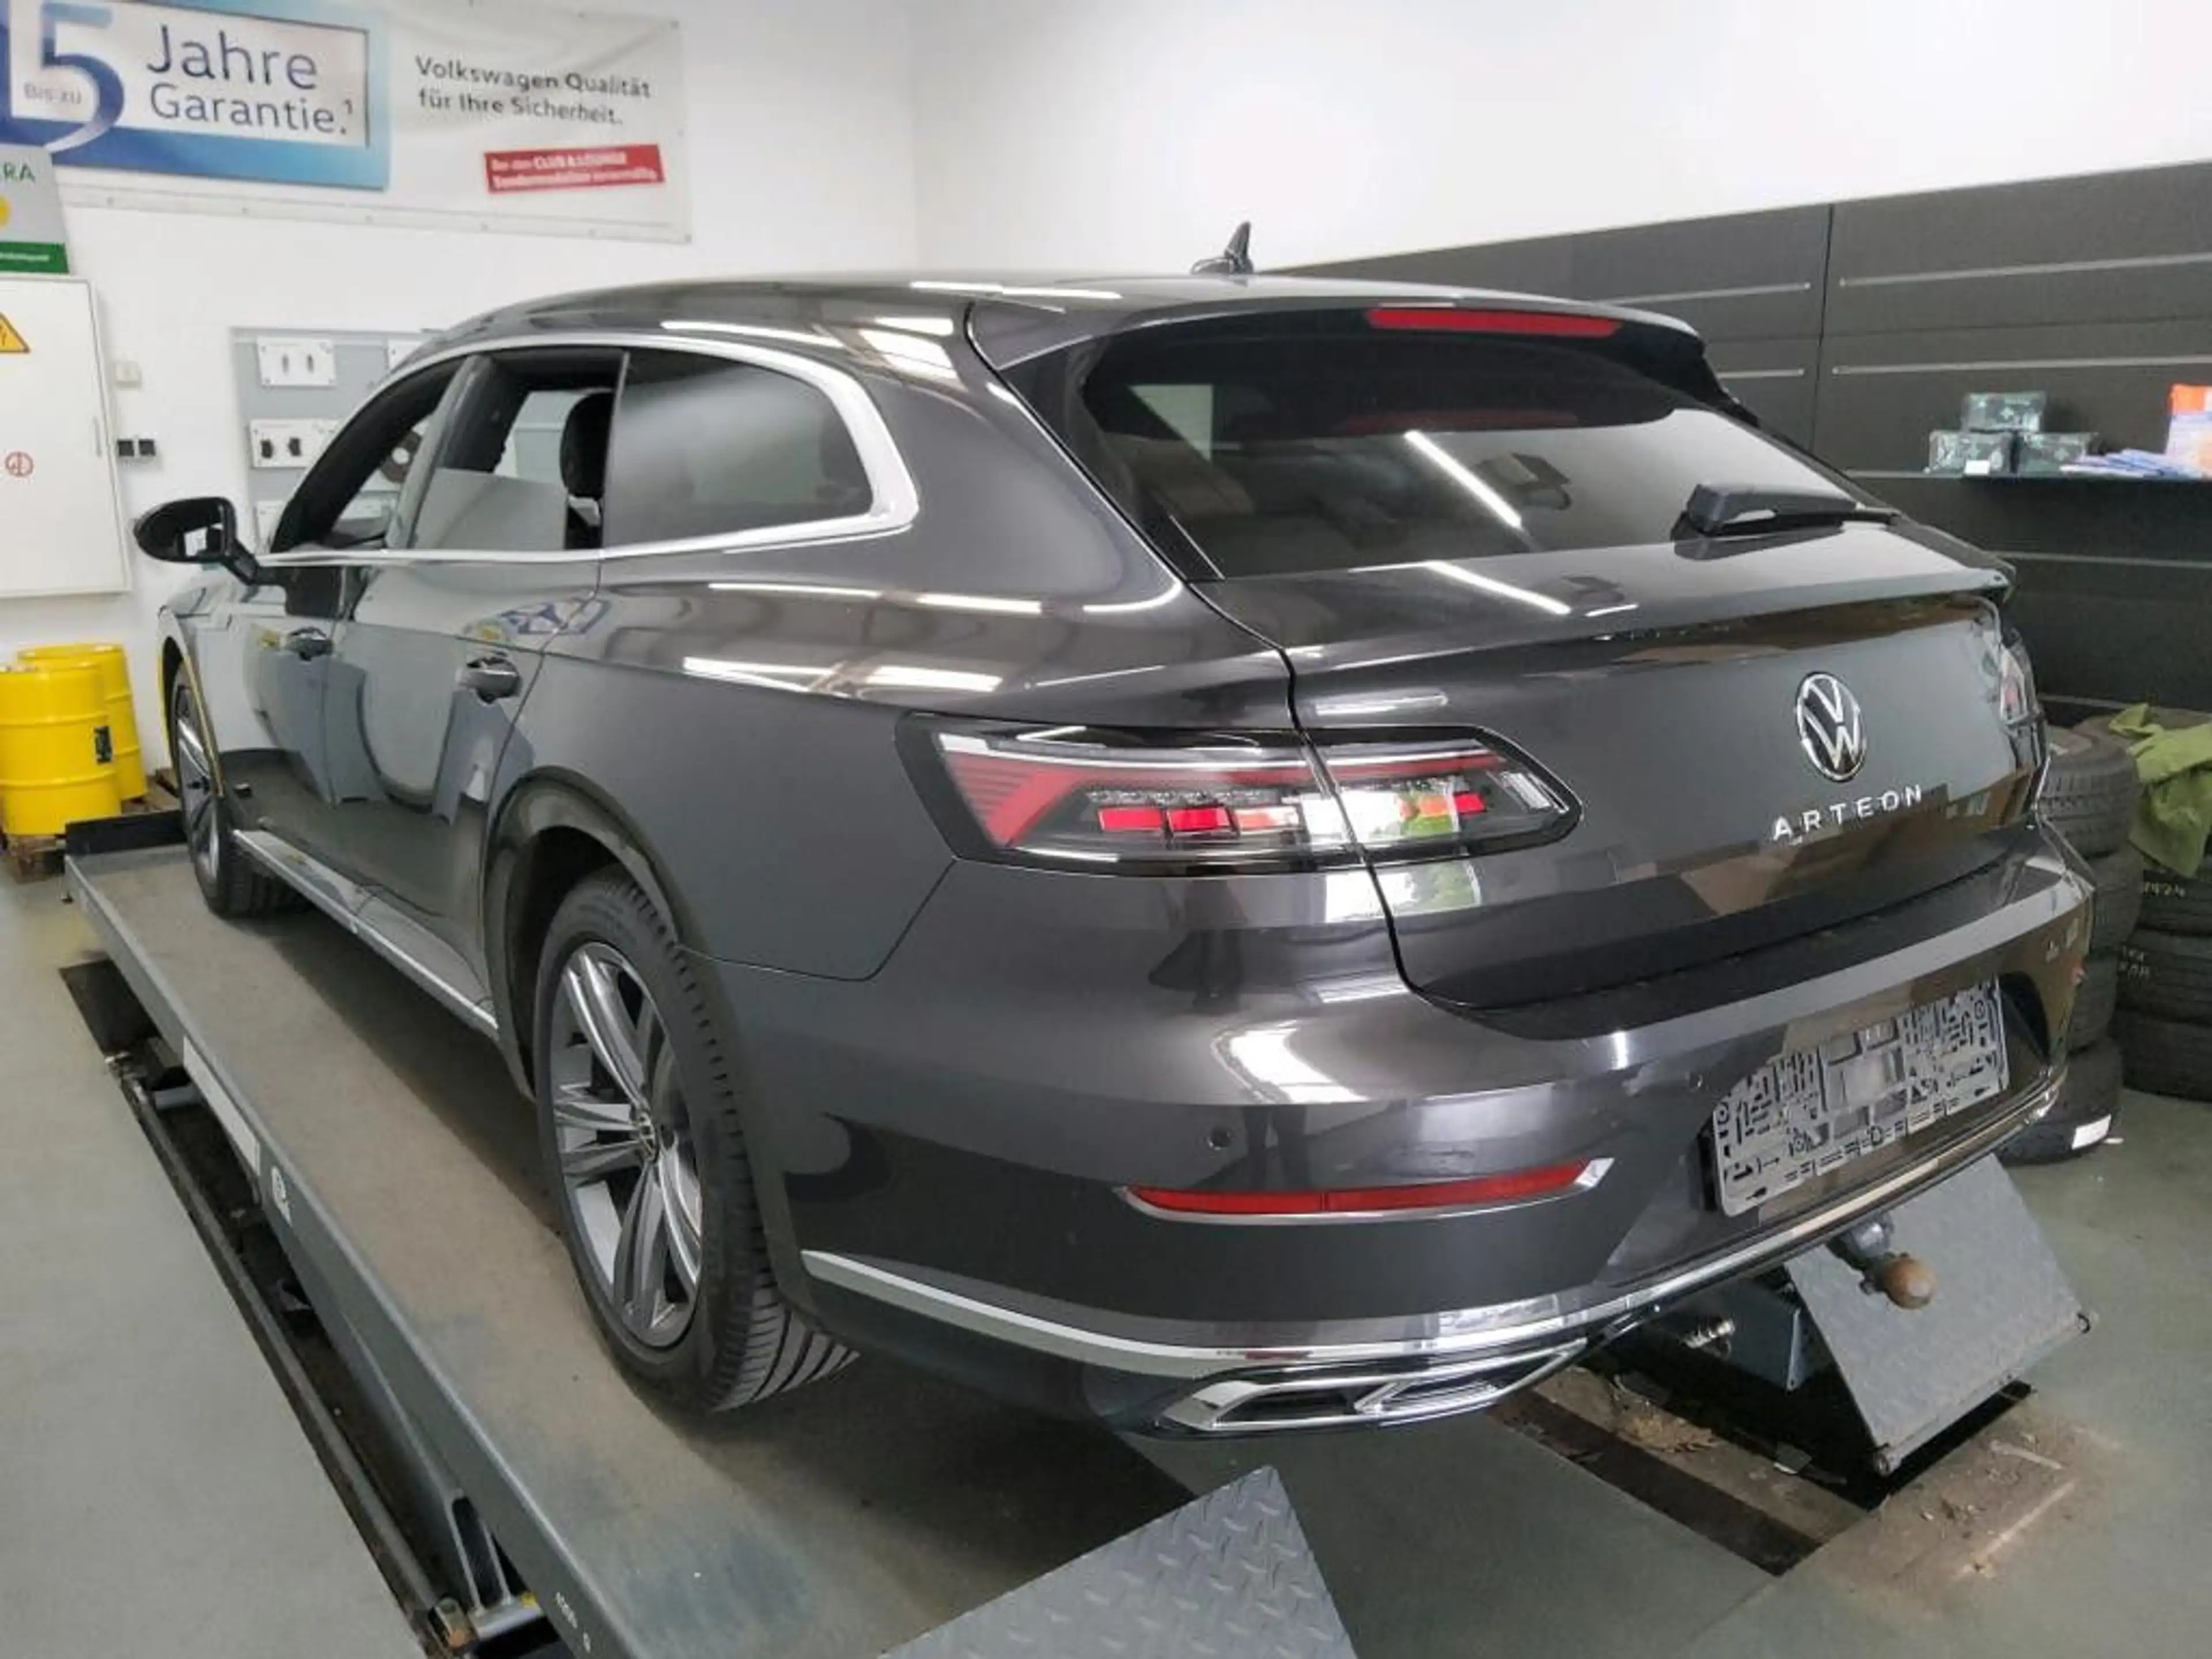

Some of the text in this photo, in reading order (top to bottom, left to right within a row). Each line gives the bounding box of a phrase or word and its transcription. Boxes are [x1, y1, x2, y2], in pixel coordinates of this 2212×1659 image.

[146, 24, 318, 90] Jahre
[415, 54, 652, 99] Volkswagen Qualität
[419, 86, 623, 124] für Ihre Sicherheit.
[1771, 784, 1922, 841] ARTEON
